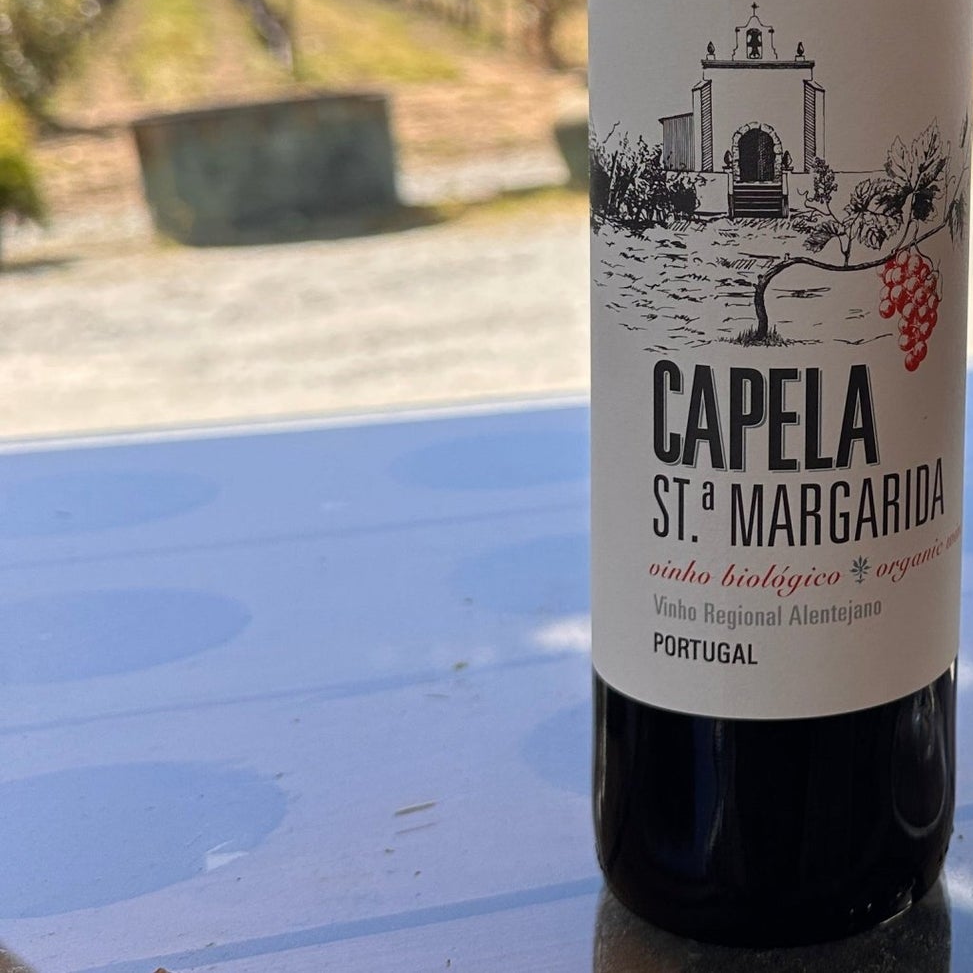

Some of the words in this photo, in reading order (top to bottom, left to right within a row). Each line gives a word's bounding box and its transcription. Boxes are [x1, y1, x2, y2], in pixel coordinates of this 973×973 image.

[652, 359, 881, 473] CAPELA
[730, 457, 945, 548] MARGARIDA
[649, 558, 712, 587] vinho
[721, 562, 841, 598] biológico
[876, 538, 944, 583] organic
[653, 593, 697, 623] Vinho
[703, 602, 783, 631] Regional
[789, 598, 883, 627] Alentejano
[653, 631, 759, 666] PORTUGAL
